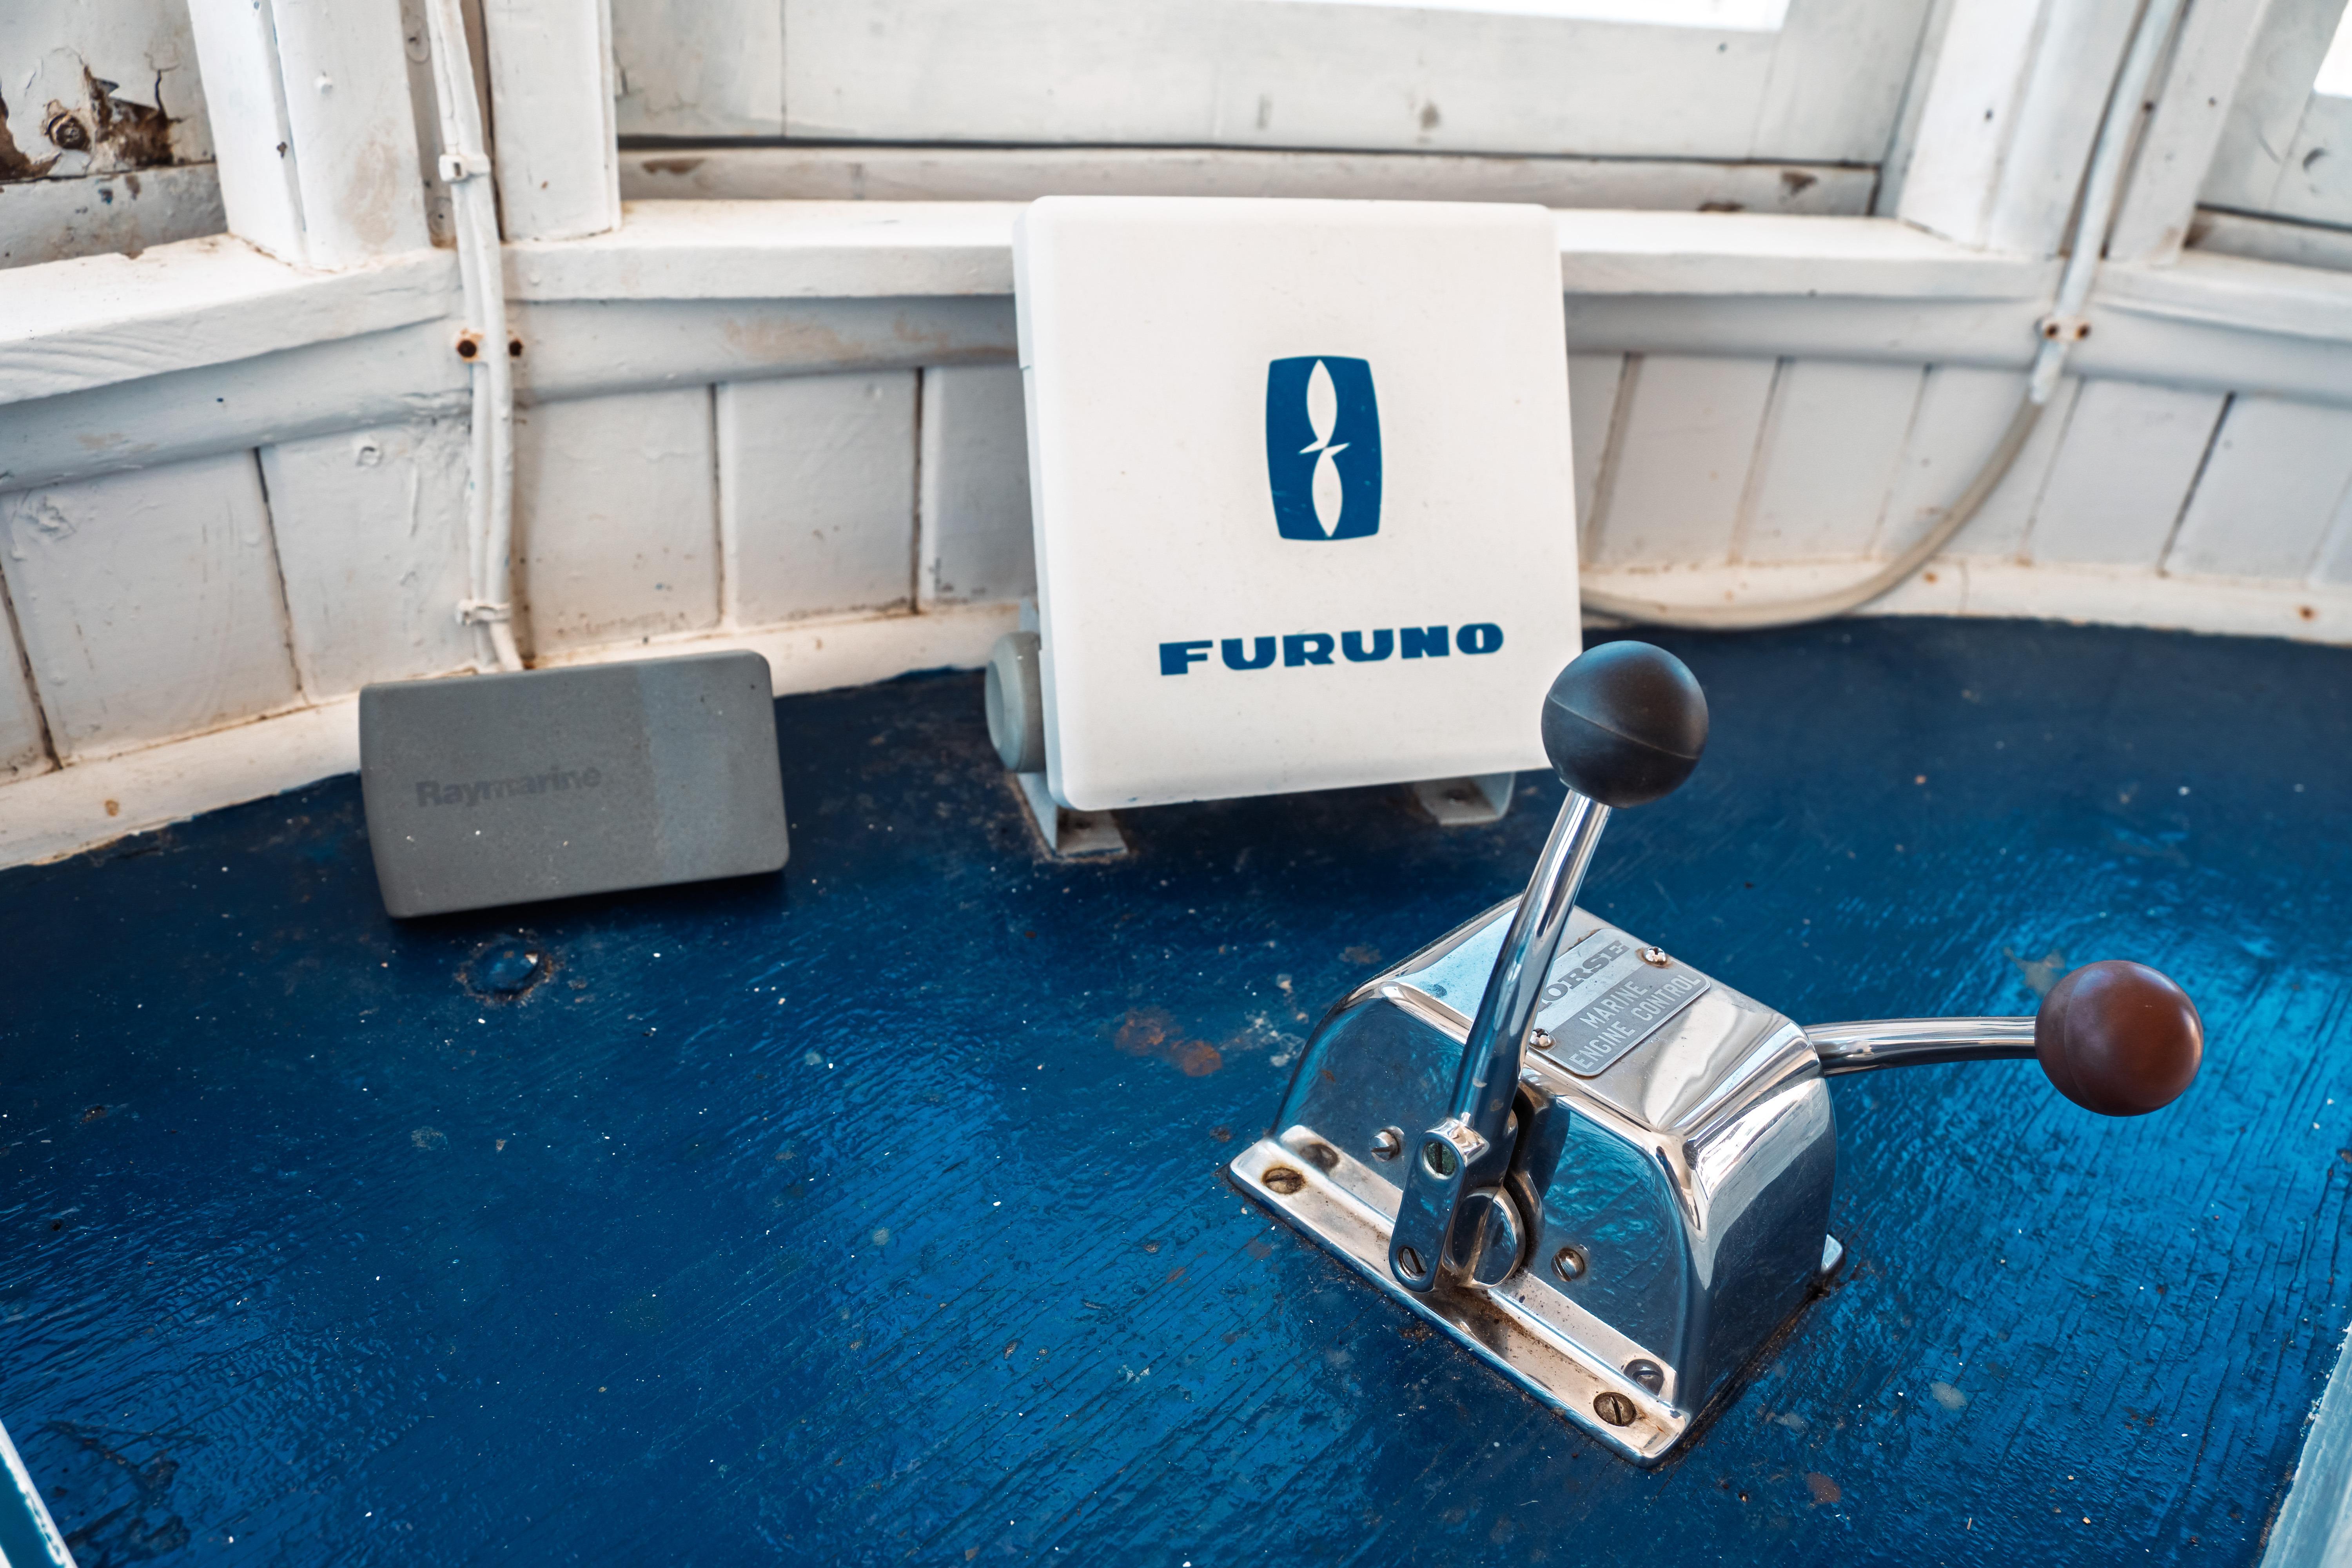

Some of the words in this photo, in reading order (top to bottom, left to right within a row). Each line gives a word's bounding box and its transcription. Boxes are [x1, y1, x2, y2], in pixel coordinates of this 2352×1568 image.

[1159, 622, 1504, 675] FURUNO
[415, 766, 601, 808] Raymarine
[1537, 940, 1630, 1013] ORSE
[1569, 1021, 1635, 1069] ENGINE
[1631, 974, 1701, 1021] CONTROL
[1579, 980, 1648, 1029] MARINE
